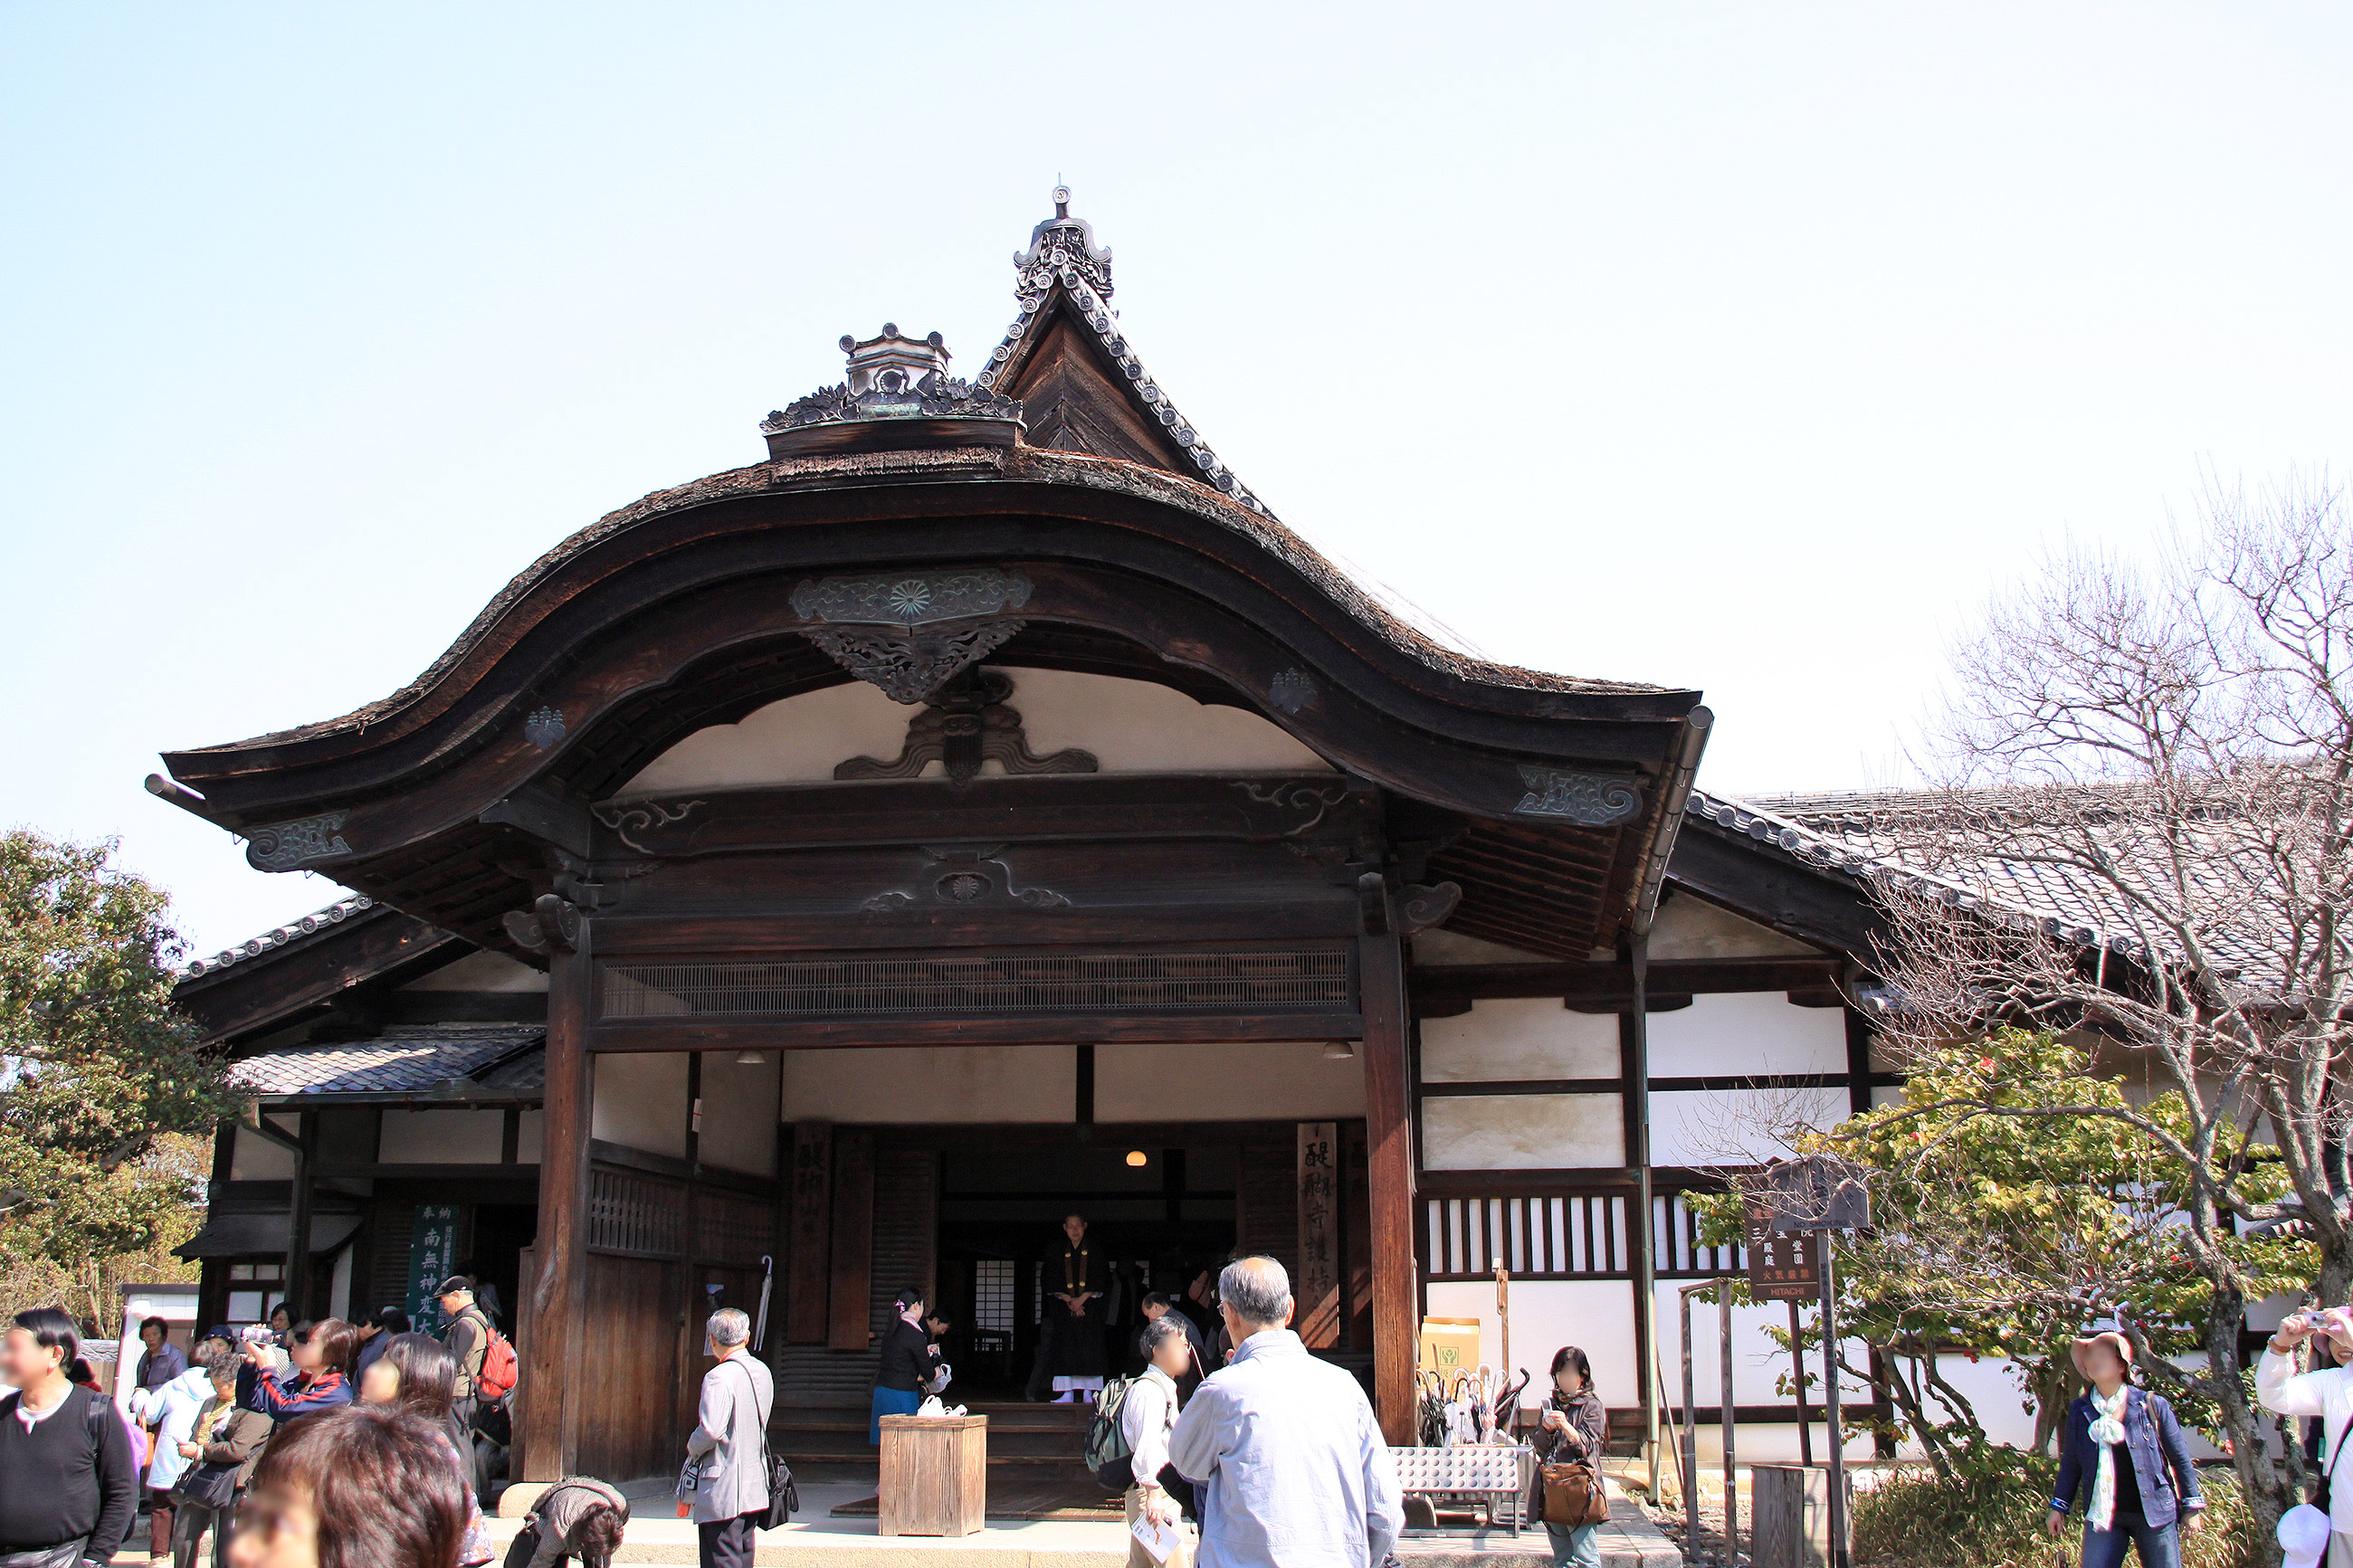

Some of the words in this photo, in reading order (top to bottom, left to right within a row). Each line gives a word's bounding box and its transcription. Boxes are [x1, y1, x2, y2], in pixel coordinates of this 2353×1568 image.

[1809, 1219, 1848, 1228] SMOKING
[1763, 1269, 1810, 1280] 火気厳禁
[417, 1228, 441, 1337] 南無神変大
[1770, 1288, 1805, 1297] HITACHI
